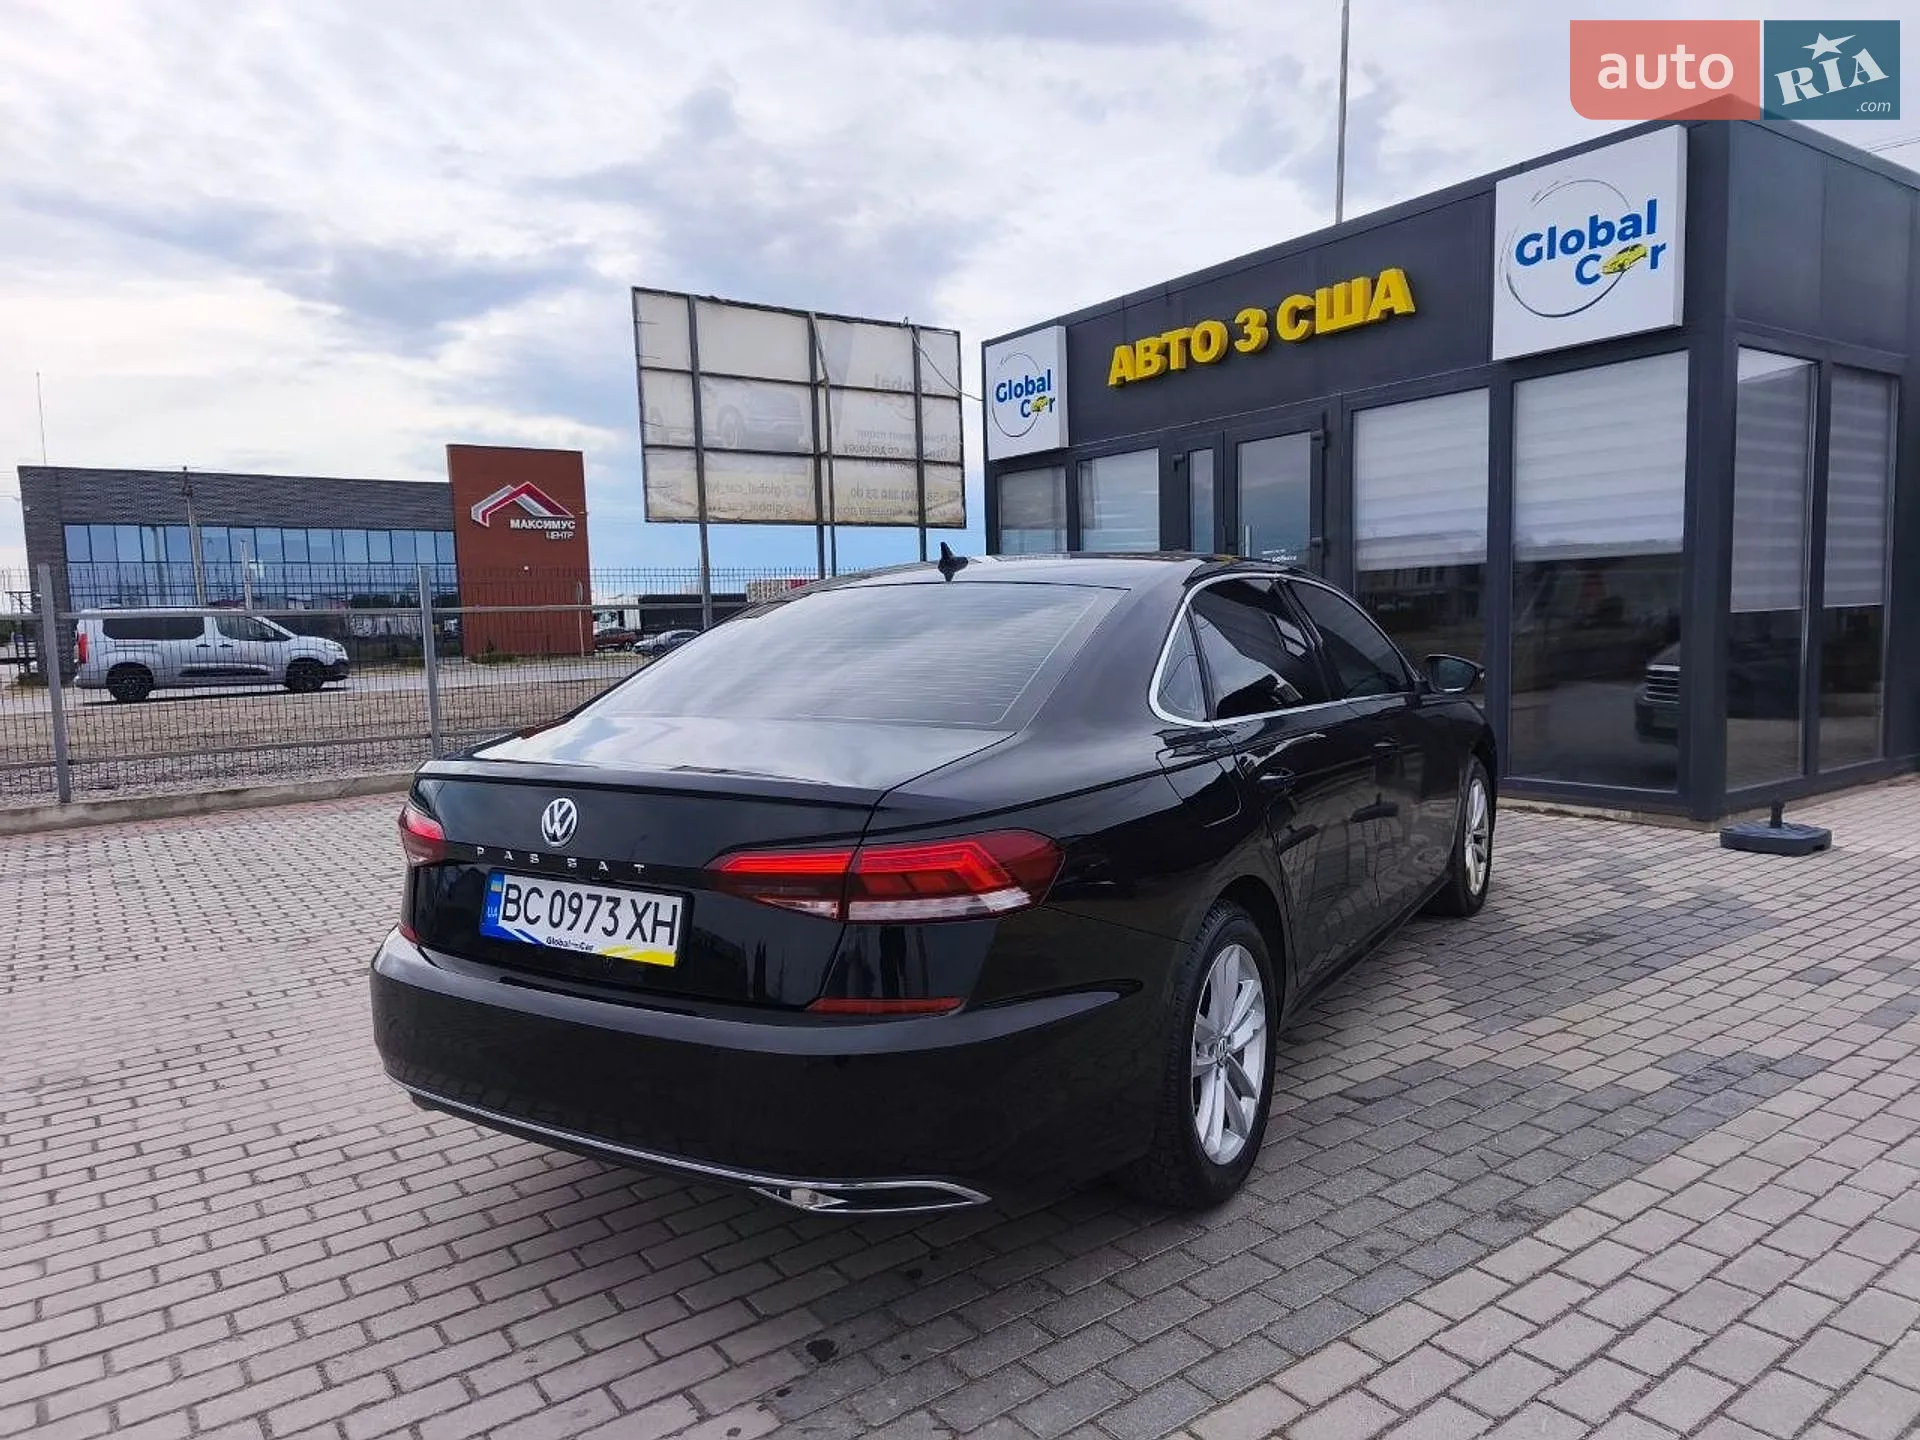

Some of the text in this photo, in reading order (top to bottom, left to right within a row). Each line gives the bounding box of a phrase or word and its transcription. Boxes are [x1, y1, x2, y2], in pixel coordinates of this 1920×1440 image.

[1515, 198, 1658, 267] Global
[1108, 319, 1229, 387] АВТО
[1276, 267, 1416, 343] США
[995, 368, 1052, 403] Global
[509, 519, 576, 530] МАКСИМУС
[545, 531, 574, 540] ЦЕНТР
[475, 846, 646, 874] PASSAT
